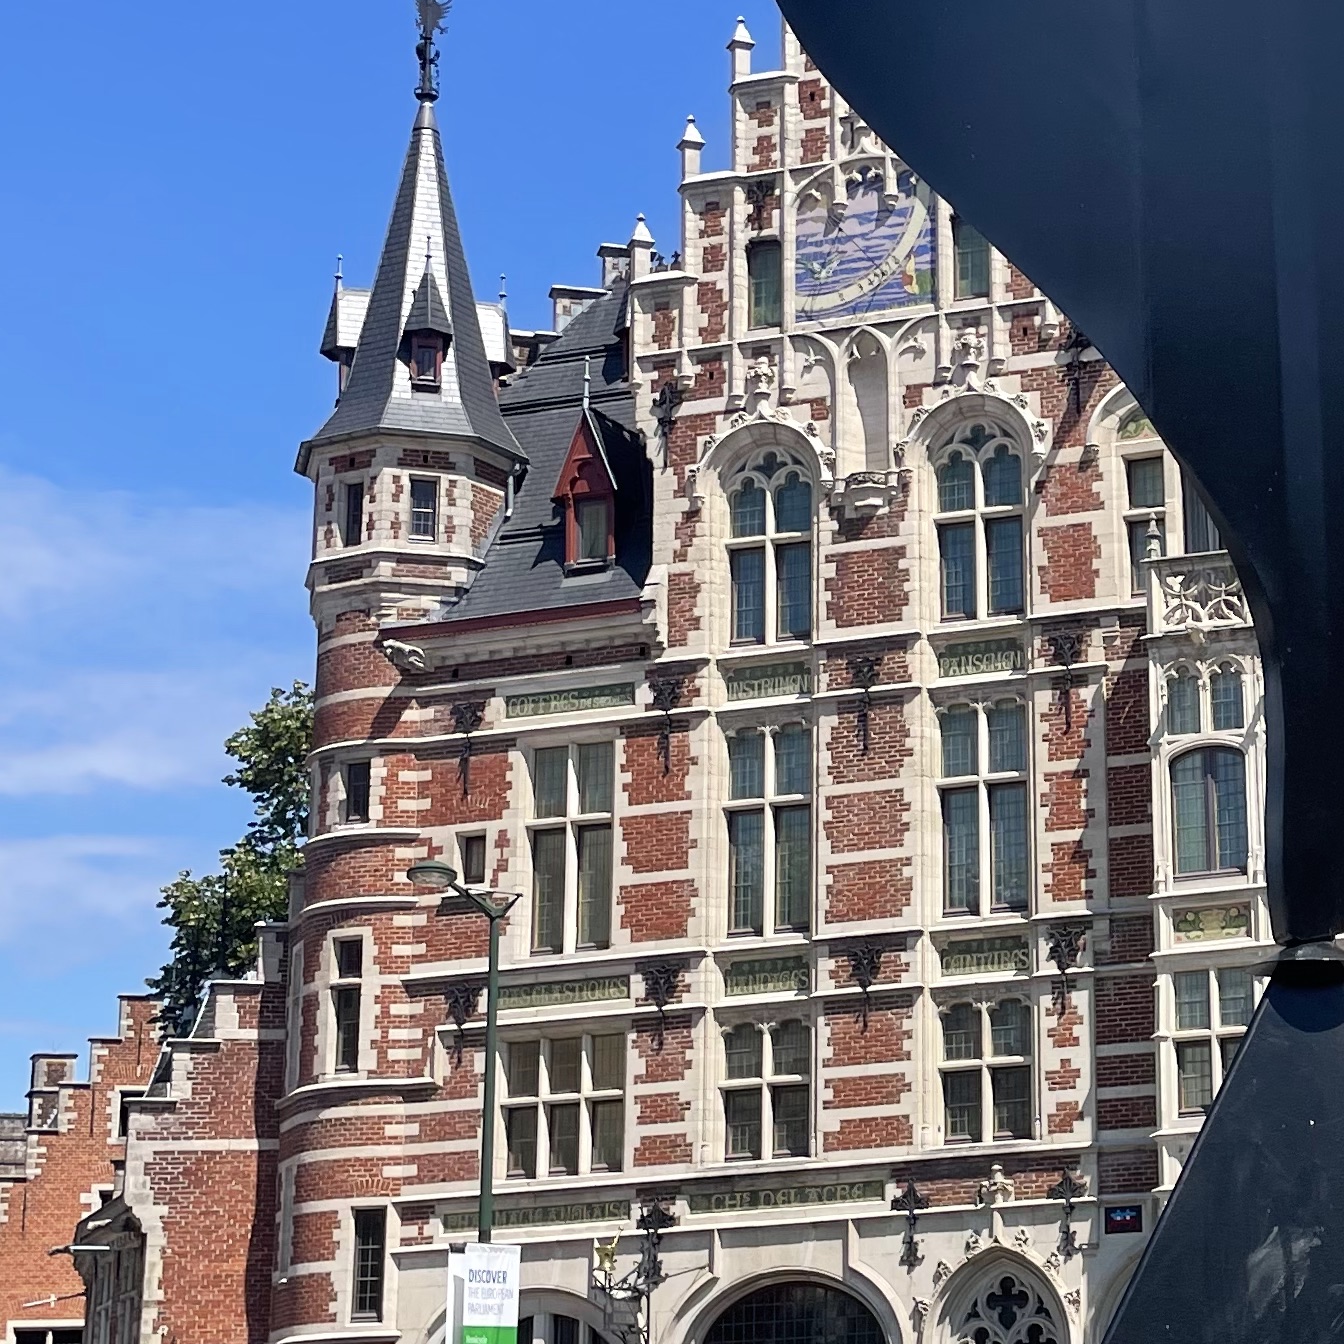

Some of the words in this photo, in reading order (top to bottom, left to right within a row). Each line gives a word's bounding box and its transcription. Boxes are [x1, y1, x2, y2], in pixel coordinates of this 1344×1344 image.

[508, 691, 579, 717] COFFRES
[942, 948, 1030, 975] CEINTURES
[758, 1183, 865, 1207] DELACRE
[446, 1209, 545, 1234] PHAMACIE
[468, 1269, 507, 1284] DISCOVER
[468, 1287, 479, 1300] THE
